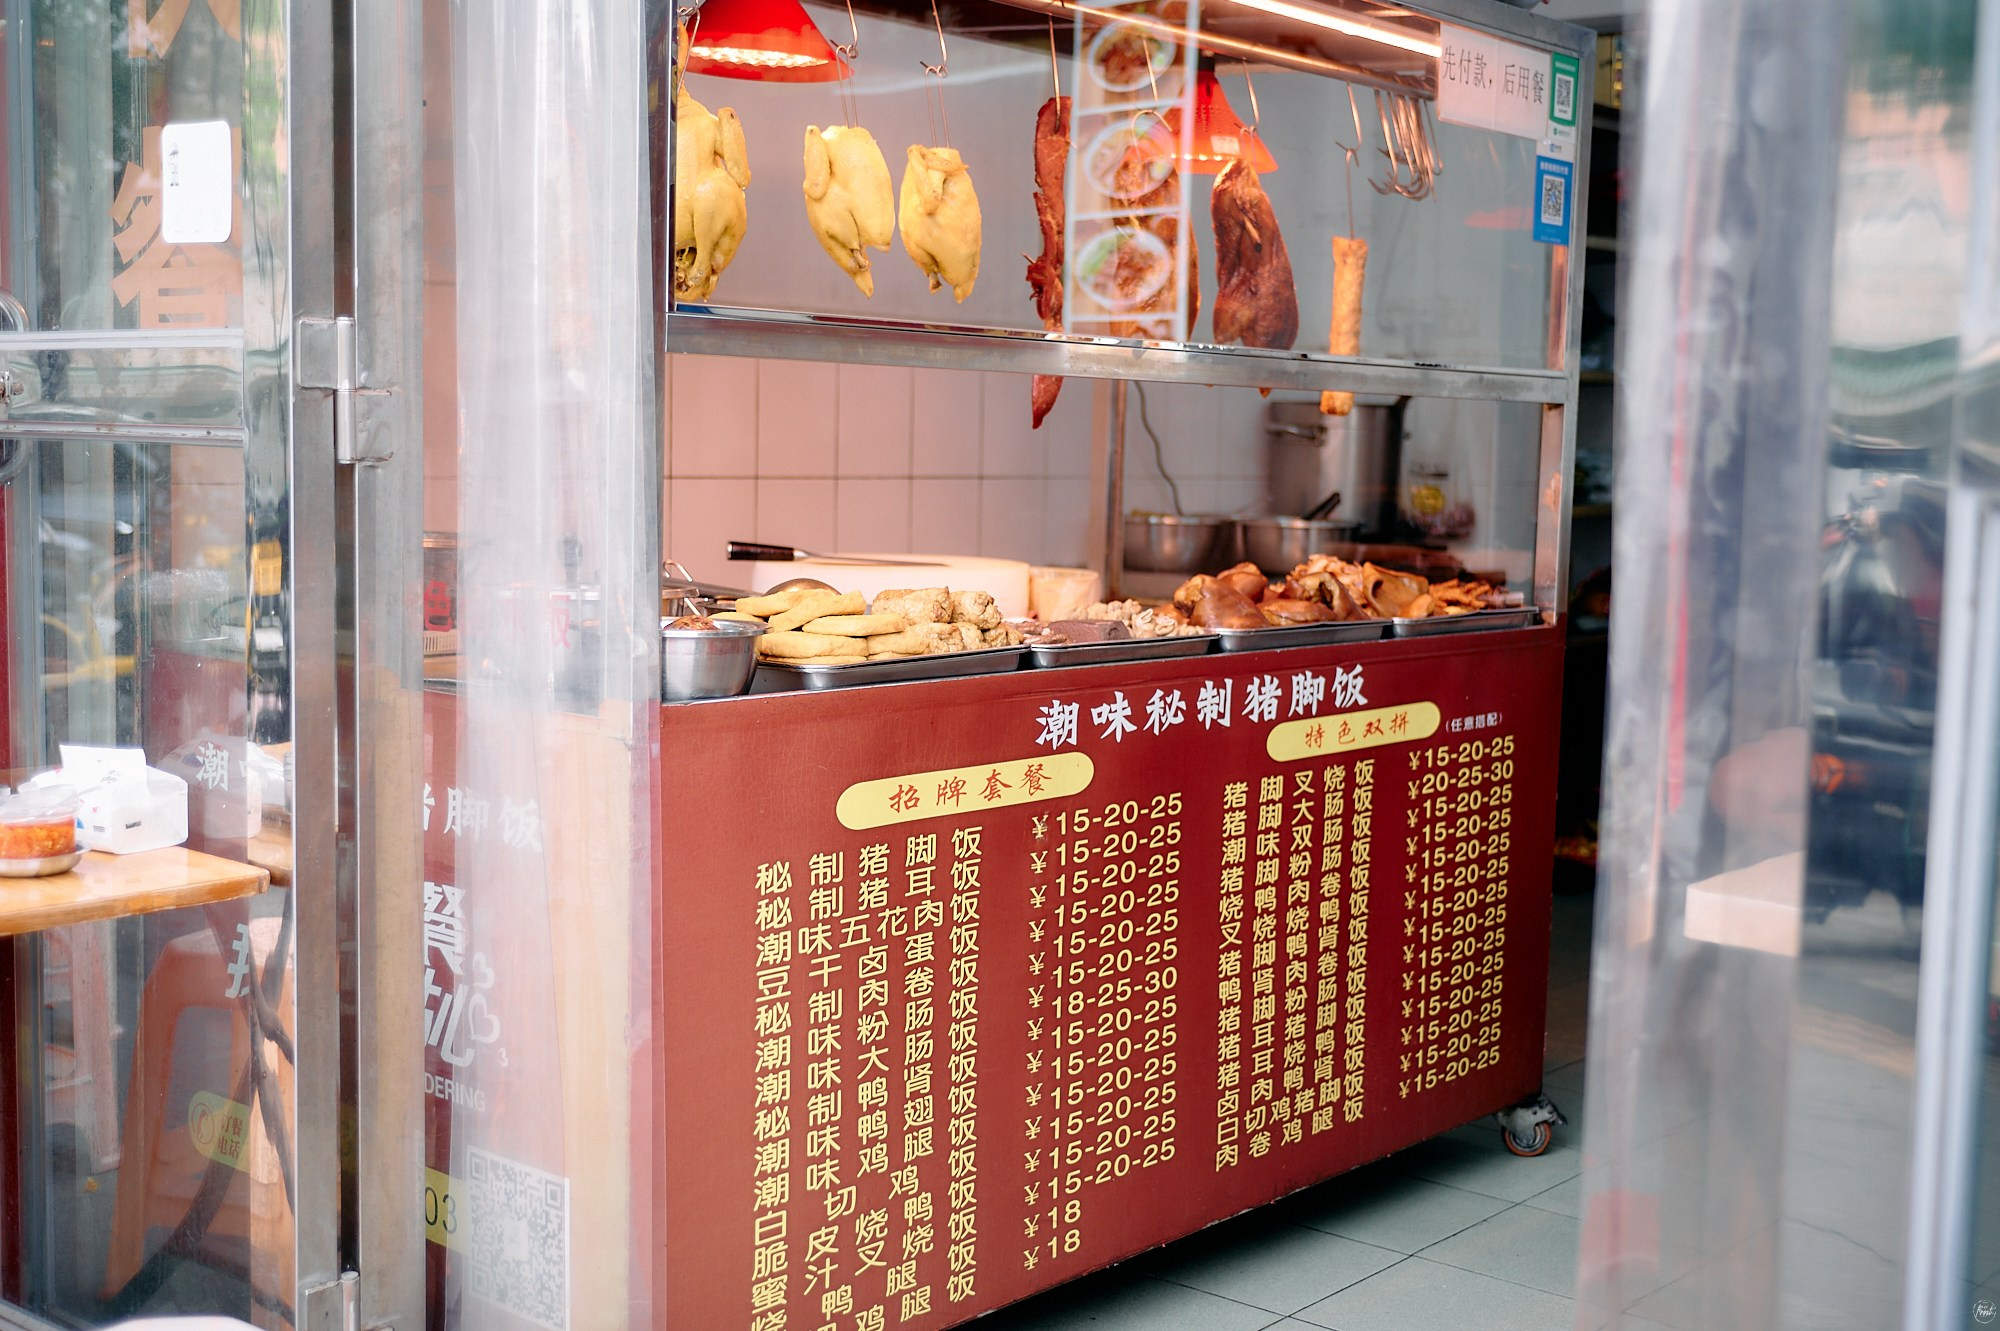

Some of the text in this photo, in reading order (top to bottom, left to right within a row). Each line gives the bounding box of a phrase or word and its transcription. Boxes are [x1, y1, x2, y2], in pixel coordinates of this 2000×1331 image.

[1034, 664, 1368, 750] 潮味秘制猪脚饭
[1305, 711, 1409, 749] 特色双拼
[889, 762, 1052, 813] 招牌套餐
[1223, 786, 1372, 837] 猪脚大肠饭
[1224, 759, 1374, 809] 猪脚叉烧饭
[755, 827, 982, 896] 秘制猪脚饭
[1220, 838, 1370, 897] 猪脚粉肠饭
[1222, 812, 1371, 865] 潮味双肠饭
[755, 859, 981, 931] 秘制猪耳饭
[756, 891, 980, 967] 潮味五花肉饭
[1219, 890, 1368, 949] 叉烧烧鸭饭
[1220, 864, 1369, 922] 烧鸭肉卷饭
[755, 922, 979, 1002] 豆干卤蛋饭
[1218, 916, 1367, 978] 猪脚鸭肾饭
[1219, 942, 1367, 1006] 鸭肾肉卷饭
[754, 954, 979, 1037] 秘制肉卷饭
[755, 986, 978, 1073] 潮味粉肠饭
[1218, 967, 1366, 1034] 猪脚粉肠饭
[1218, 993, 1365, 1062] 猪耳猪脚饭
[755, 1018, 977, 1108] 潮味大肠饭
[1217, 1019, 1365, 1089] 猪耳烧鸭饭
[1218, 1044, 1364, 1117] 卤肉鸭肾饭
[753, 1049, 977, 1141] 秘制鸭肾饭
[754, 1081, 977, 1177] 潮味鸭翅饭
[1218, 1070, 1364, 1144] 白切鸡猪脚饭
[753, 1112, 977, 1212] 潮味鸡腿饭
[1216, 1096, 1363, 1172] 肉卷鸡腿饭
[752, 1175, 977, 1281] 脆皮烧鸭饭
[755, 1144, 977, 1246] 白切鸡饭
[751, 1206, 977, 1314] 蜜汁叉烧饭
